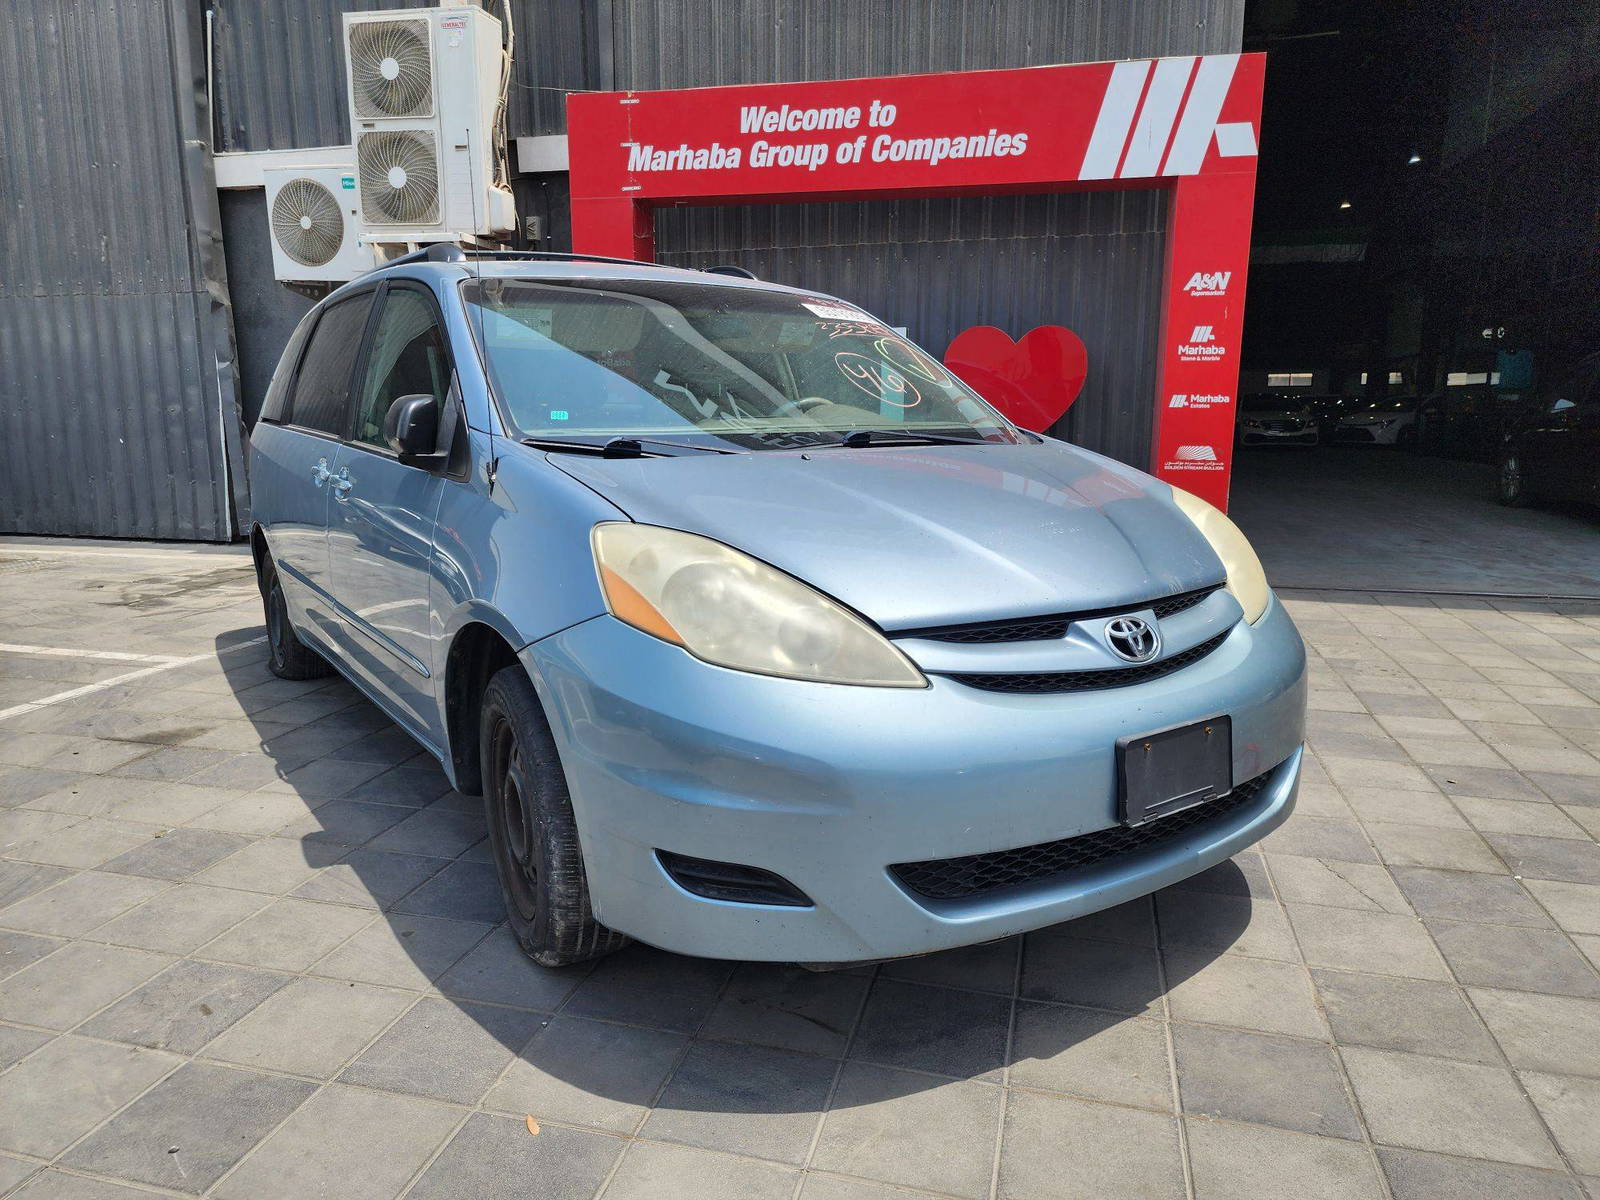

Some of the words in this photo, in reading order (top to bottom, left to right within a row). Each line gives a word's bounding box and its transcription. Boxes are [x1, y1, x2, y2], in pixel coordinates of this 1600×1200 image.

[740, 104, 862, 134] Welcome
[868, 99, 897, 128] to
[627, 142, 742, 172] Marhaba
[750, 140, 828, 172] Group
[835, 135, 867, 165] of
[871, 128, 1029, 166] Companies
[1183, 271, 1231, 290] A&N
[1178, 345, 1226, 355] Marhaba
[1190, 394, 1230, 403] Marhaba
